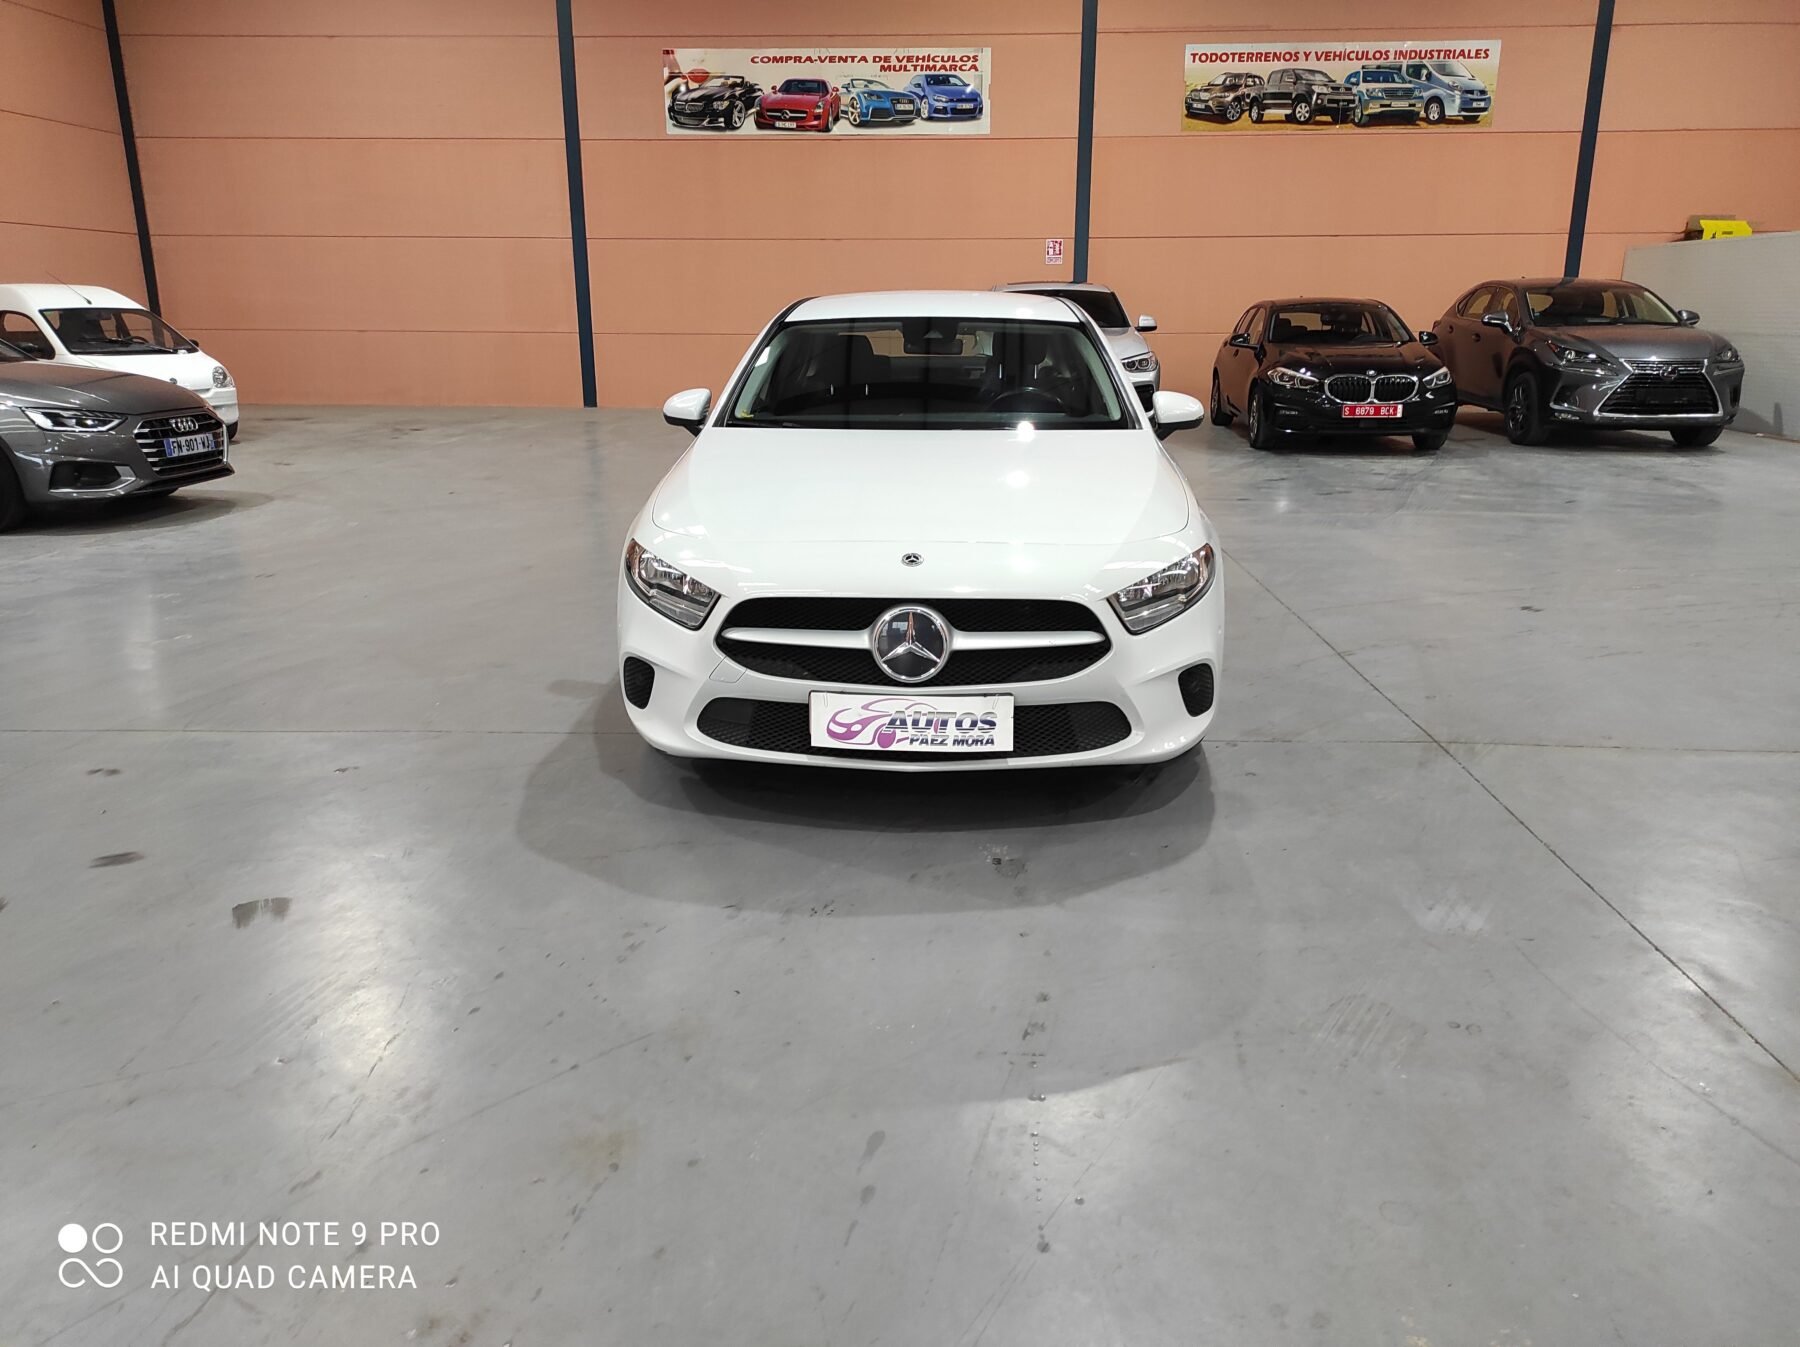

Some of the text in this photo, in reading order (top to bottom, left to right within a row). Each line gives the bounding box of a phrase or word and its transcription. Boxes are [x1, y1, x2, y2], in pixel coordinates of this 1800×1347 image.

[750, 55, 868, 64] COMPRA-VENTA
[895, 53, 979, 63] VEHÍCULOS
[1190, 48, 1490, 63] TODOTERRENOS Y VEHÍCULOS INDUSTRIALES
[879, 64, 979, 72] MULTIMARCA
[883, 710, 998, 734] AUTOS
[952, 734, 995, 747] MORA
